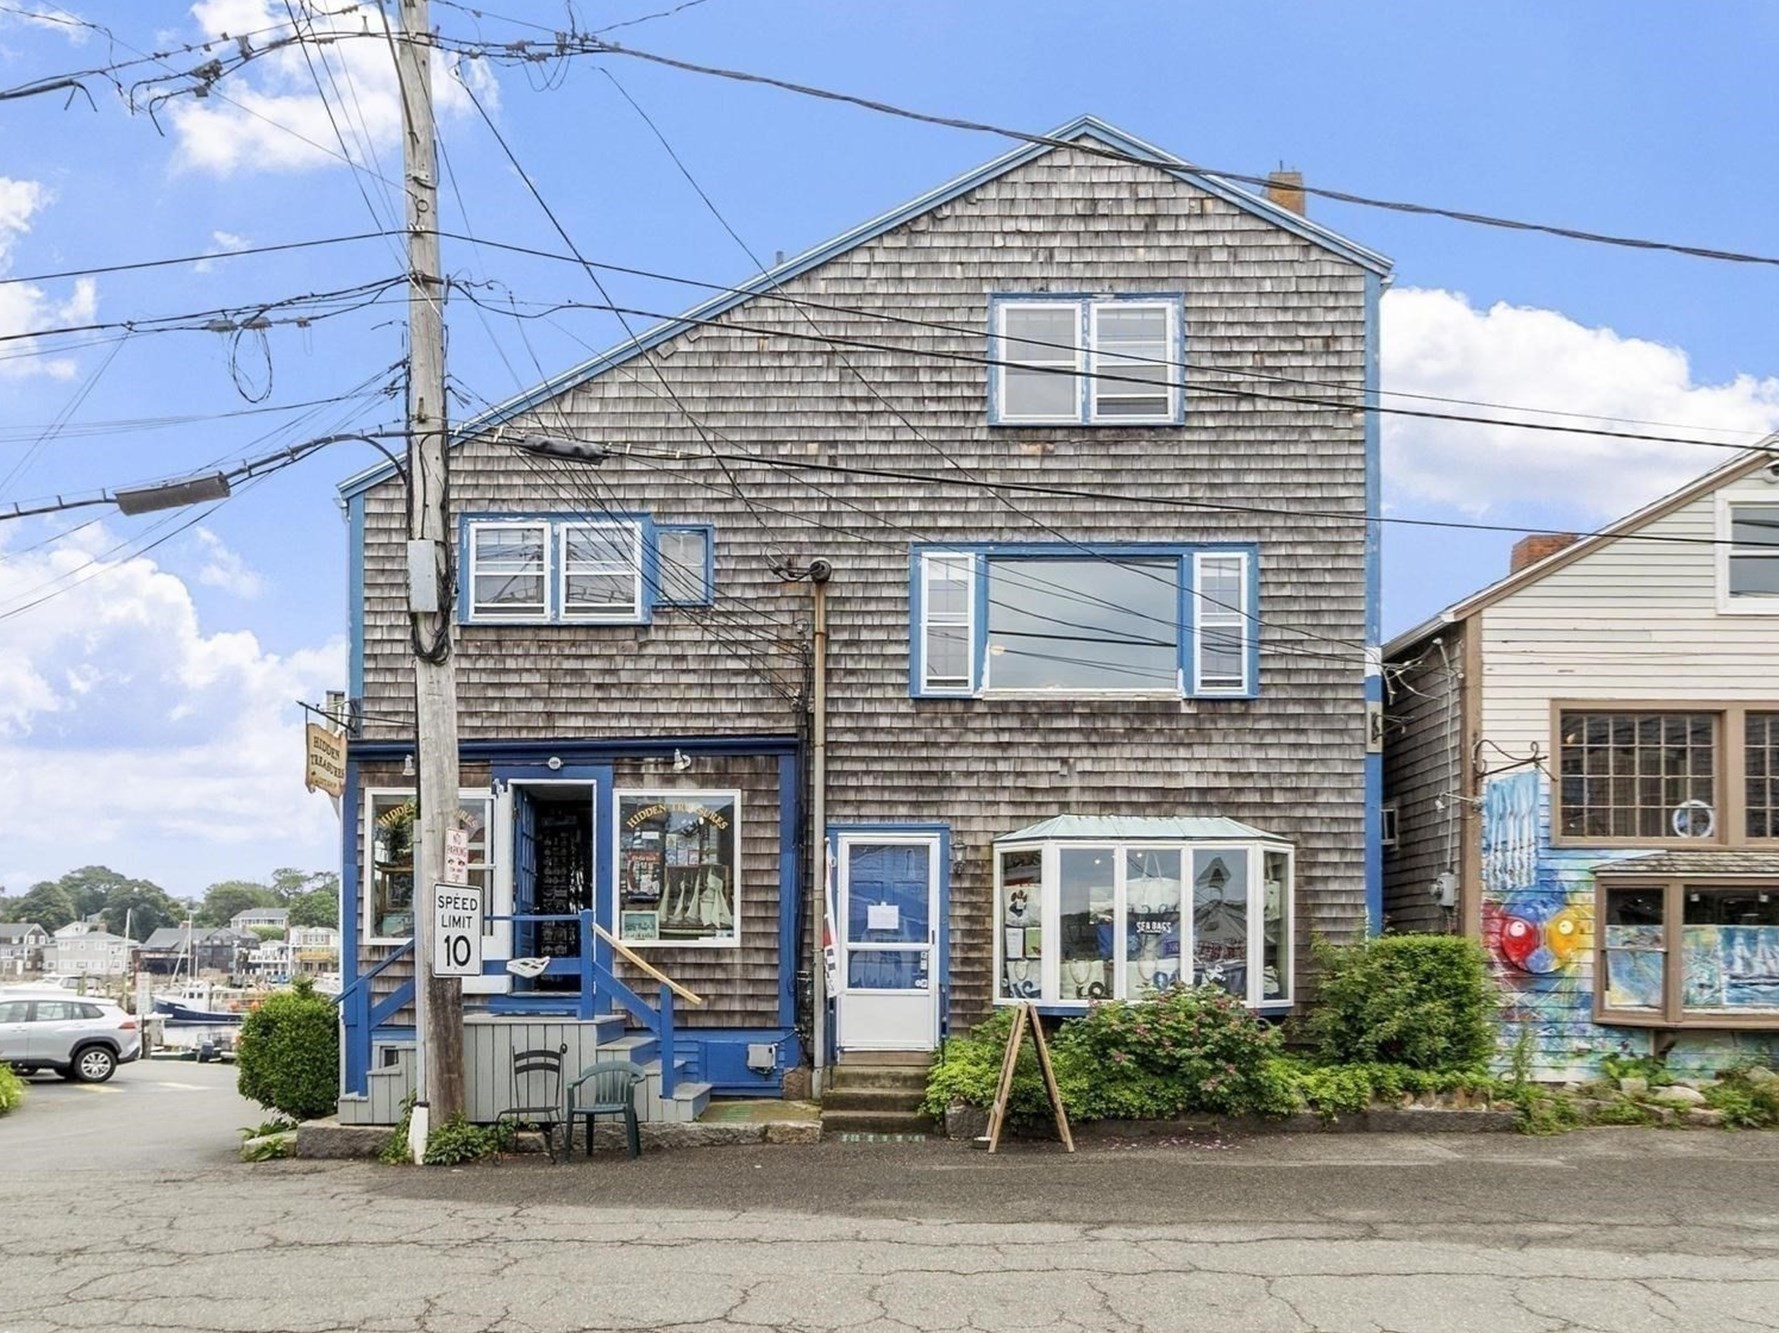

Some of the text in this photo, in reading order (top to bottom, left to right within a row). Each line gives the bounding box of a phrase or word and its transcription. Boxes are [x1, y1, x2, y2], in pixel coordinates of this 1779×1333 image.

[313, 736, 341, 761] HIDDEN
[310, 754, 345, 779] TREASURES
[378, 803, 417, 827] HIDDE
[626, 804, 667, 829] HIDDEN
[437, 895, 478, 911] SPEED
[441, 914, 473, 929] LIMIT
[1136, 921, 1151, 933] SEA
[444, 934, 471, 967] 10
